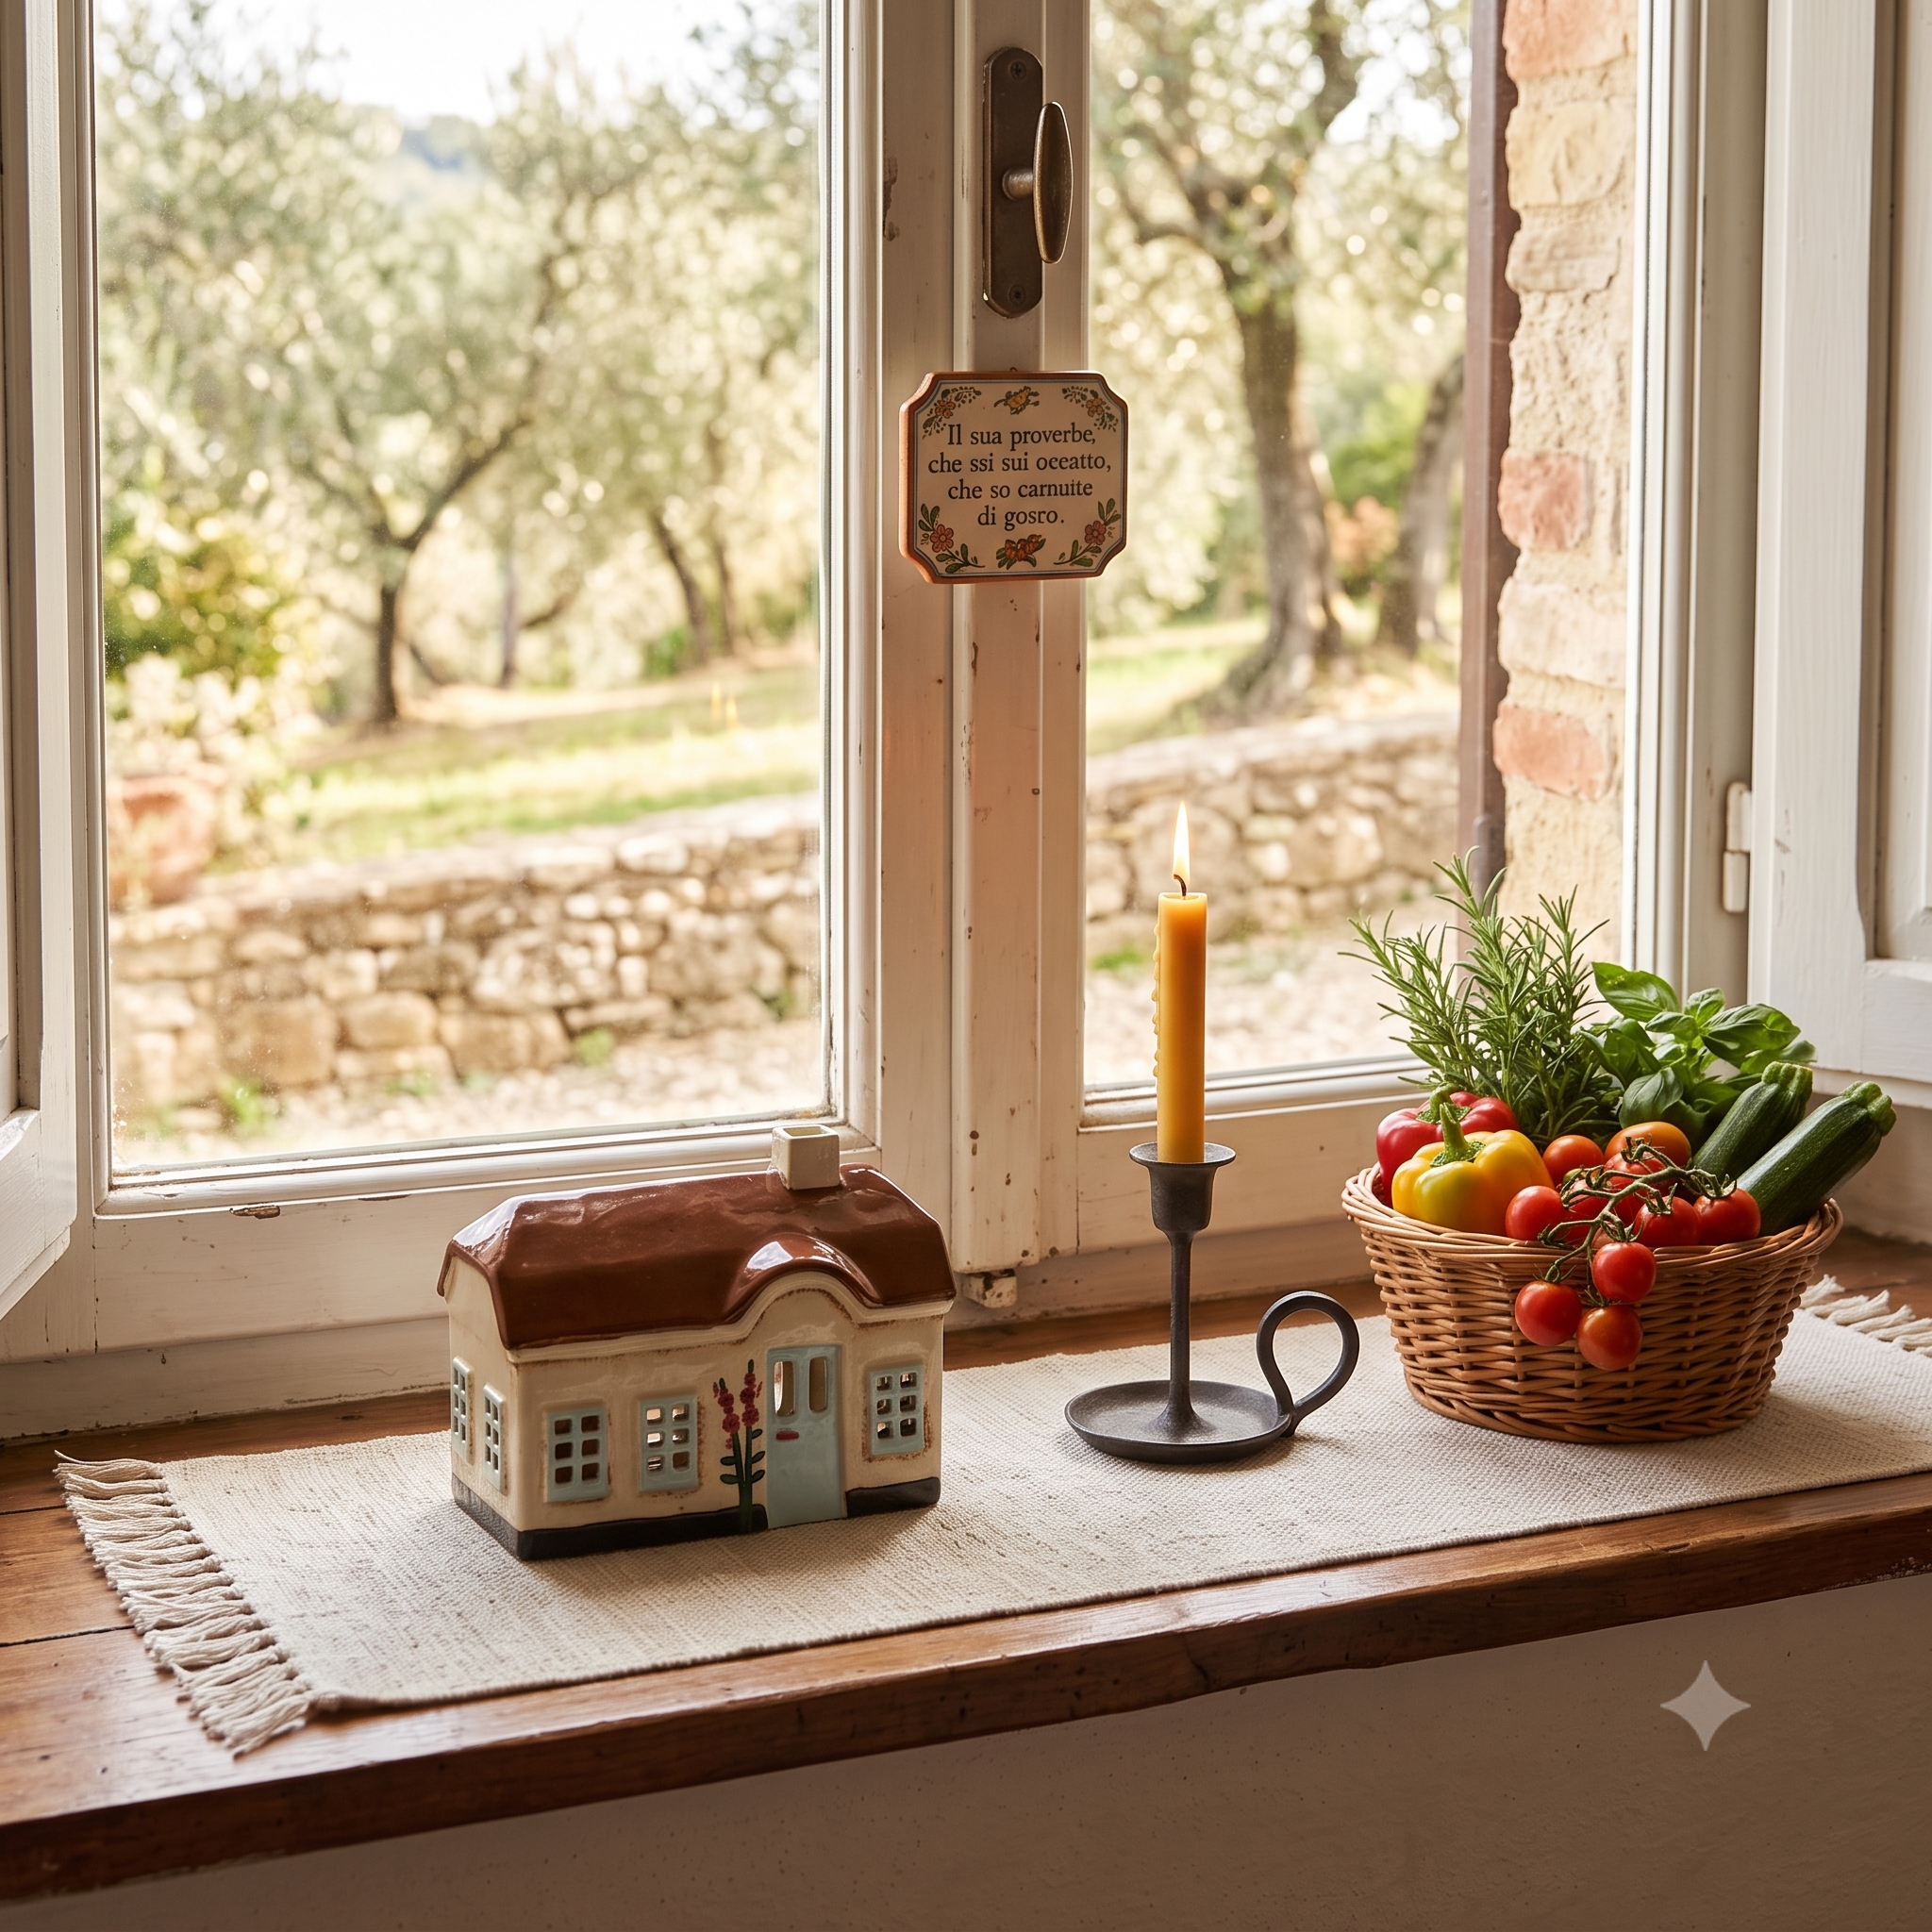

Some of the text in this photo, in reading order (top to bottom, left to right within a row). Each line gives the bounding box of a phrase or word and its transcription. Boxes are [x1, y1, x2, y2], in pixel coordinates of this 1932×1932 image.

[947, 422, 1096, 451] Il sua proverbe,
[927, 452, 962, 474] che
[970, 453, 994, 473] ssi
[1001, 452, 1029, 472] sui
[947, 478, 1093, 500] che so carnuite
[977, 505, 1065, 532] di gosro.
